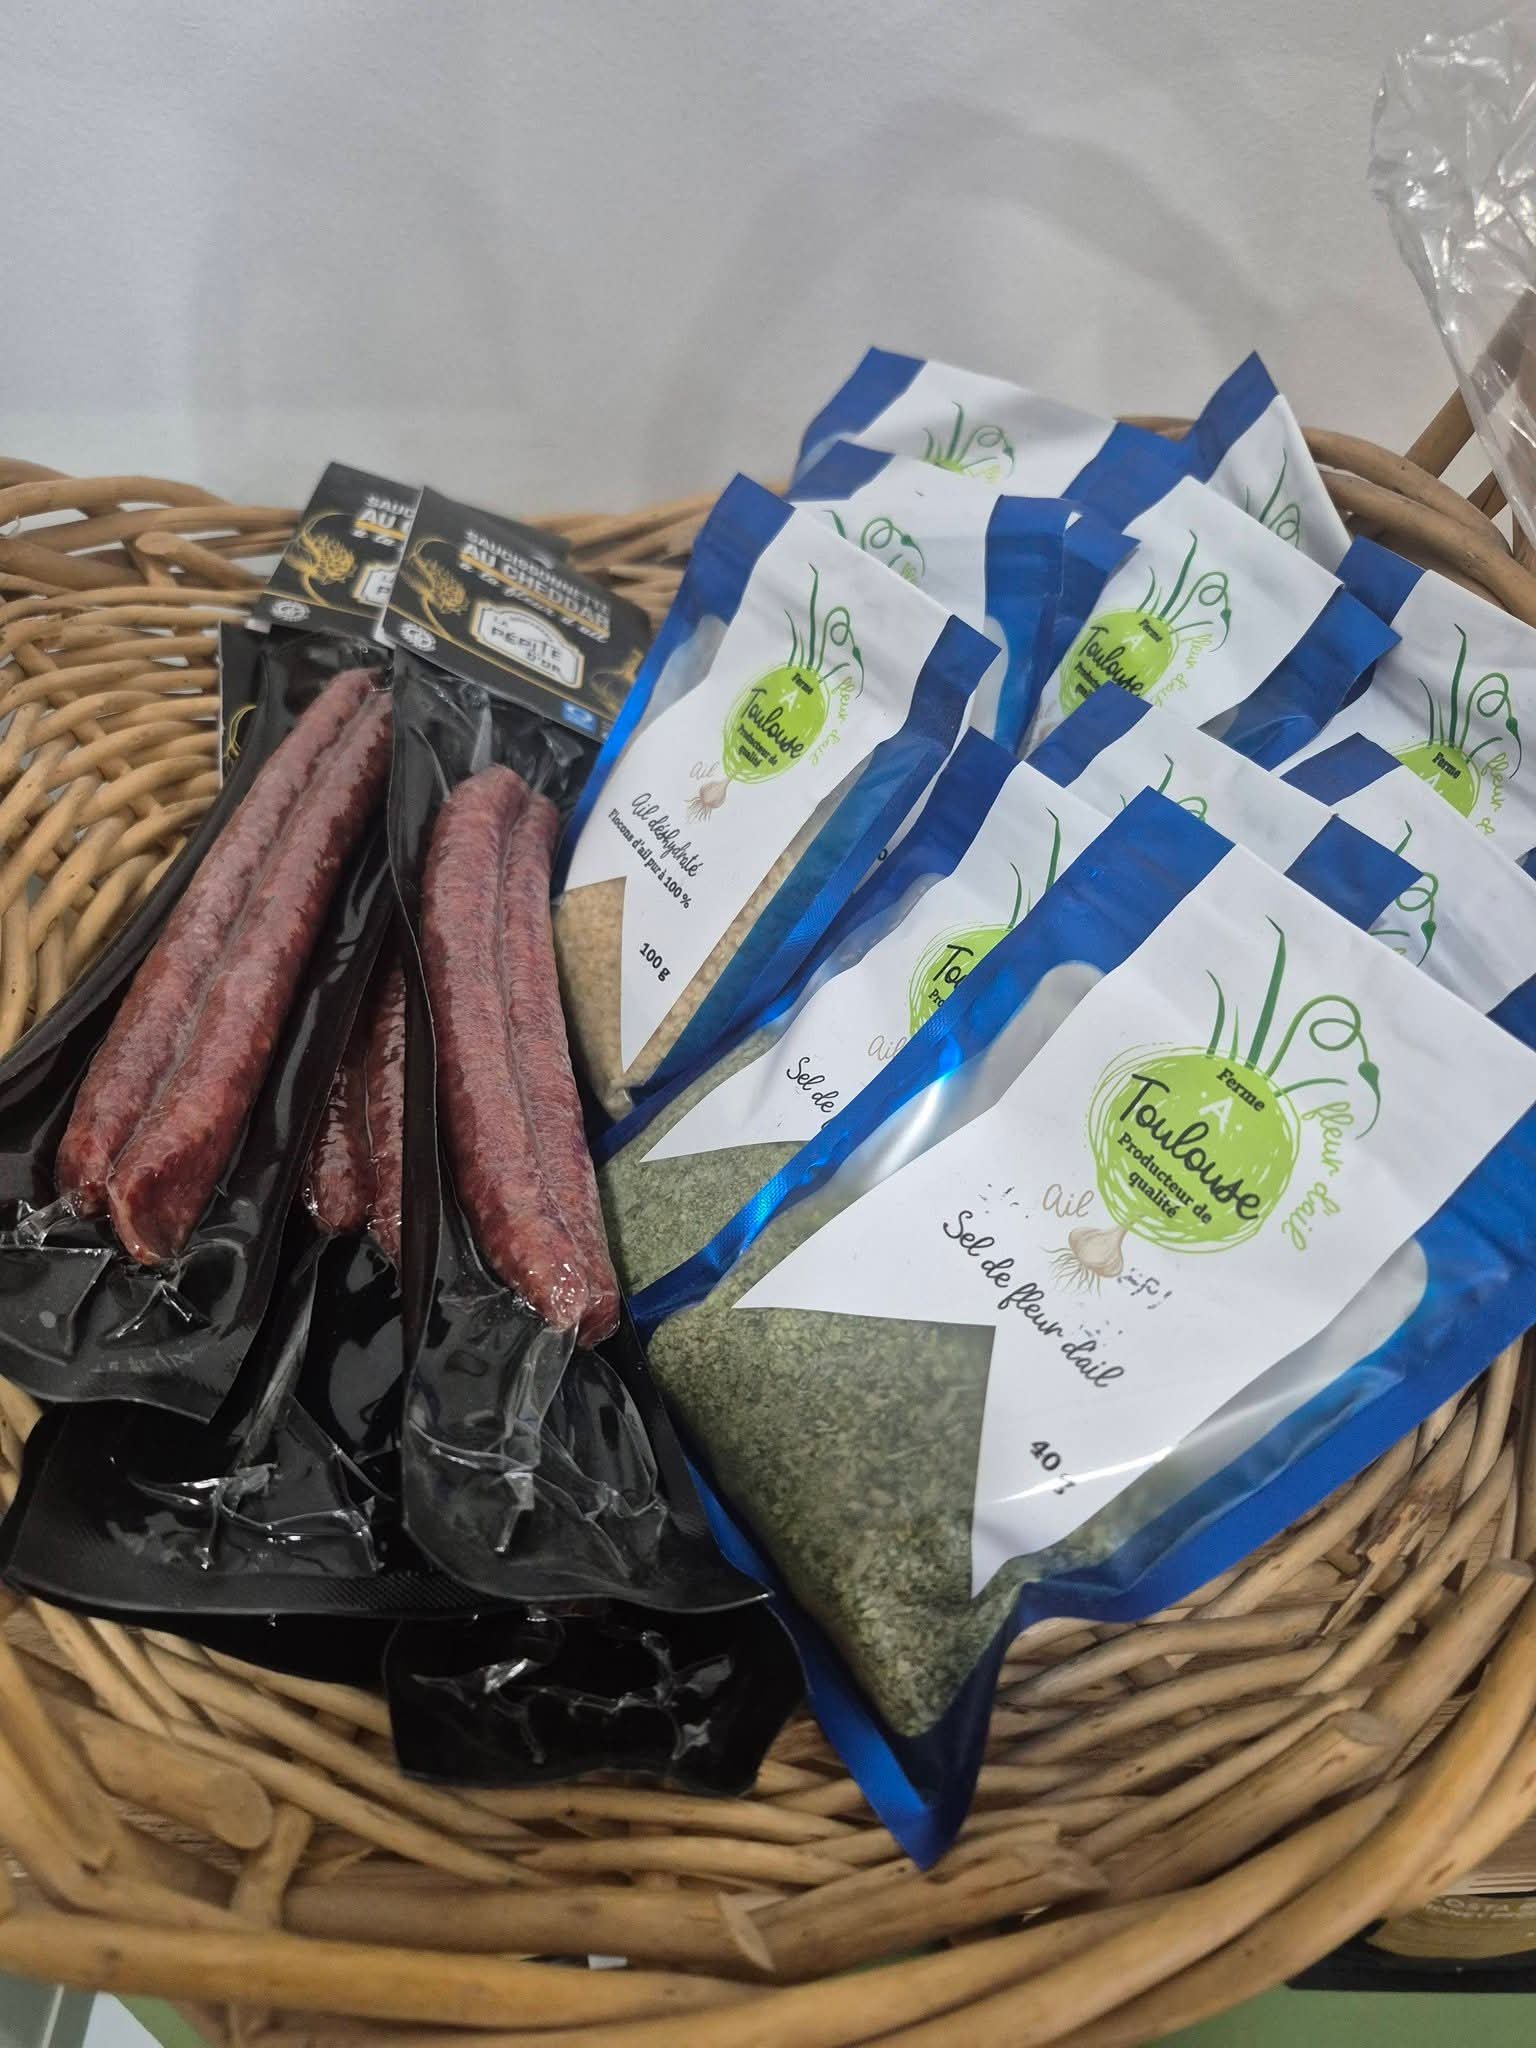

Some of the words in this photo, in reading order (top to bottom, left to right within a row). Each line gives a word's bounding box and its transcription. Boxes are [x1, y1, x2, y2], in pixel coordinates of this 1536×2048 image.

[461, 543, 496, 568] AU
[503, 563, 611, 630] CHEDDAR
[1079, 626, 1145, 696] Toulouse
[740, 687, 804, 759] Toulouse
[608, 808, 634, 842] Flocons
[631, 838, 651, 861] d'ail
[644, 856, 661, 876] pur
[657, 869, 668, 881] à
[663, 876, 683, 898] 100
[679, 893, 692, 909] %
[631, 792, 659, 821] Ail
[647, 815, 704, 878] déshydraté
[639, 942, 663, 970] 100
[658, 967, 671, 982] g
[786, 1056, 825, 1090] Sel
[811, 1090, 839, 1113] de
[1216, 1067, 1265, 1112] Ferme
[1119, 1073, 1261, 1221] Toulouse
[1301, 1101, 1354, 1177] fleur
[1117, 1132, 1194, 1208] Producteur
[1192, 1203, 1212, 1225] de
[1128, 1170, 1181, 1219] qualité
[942, 1210, 995, 1257] Sel
[980, 1257, 1015, 1288] de
[997, 1282, 1064, 1338] fleur
[1060, 1340, 1125, 1388] d'ail
[1030, 1440, 1062, 1472] 40
